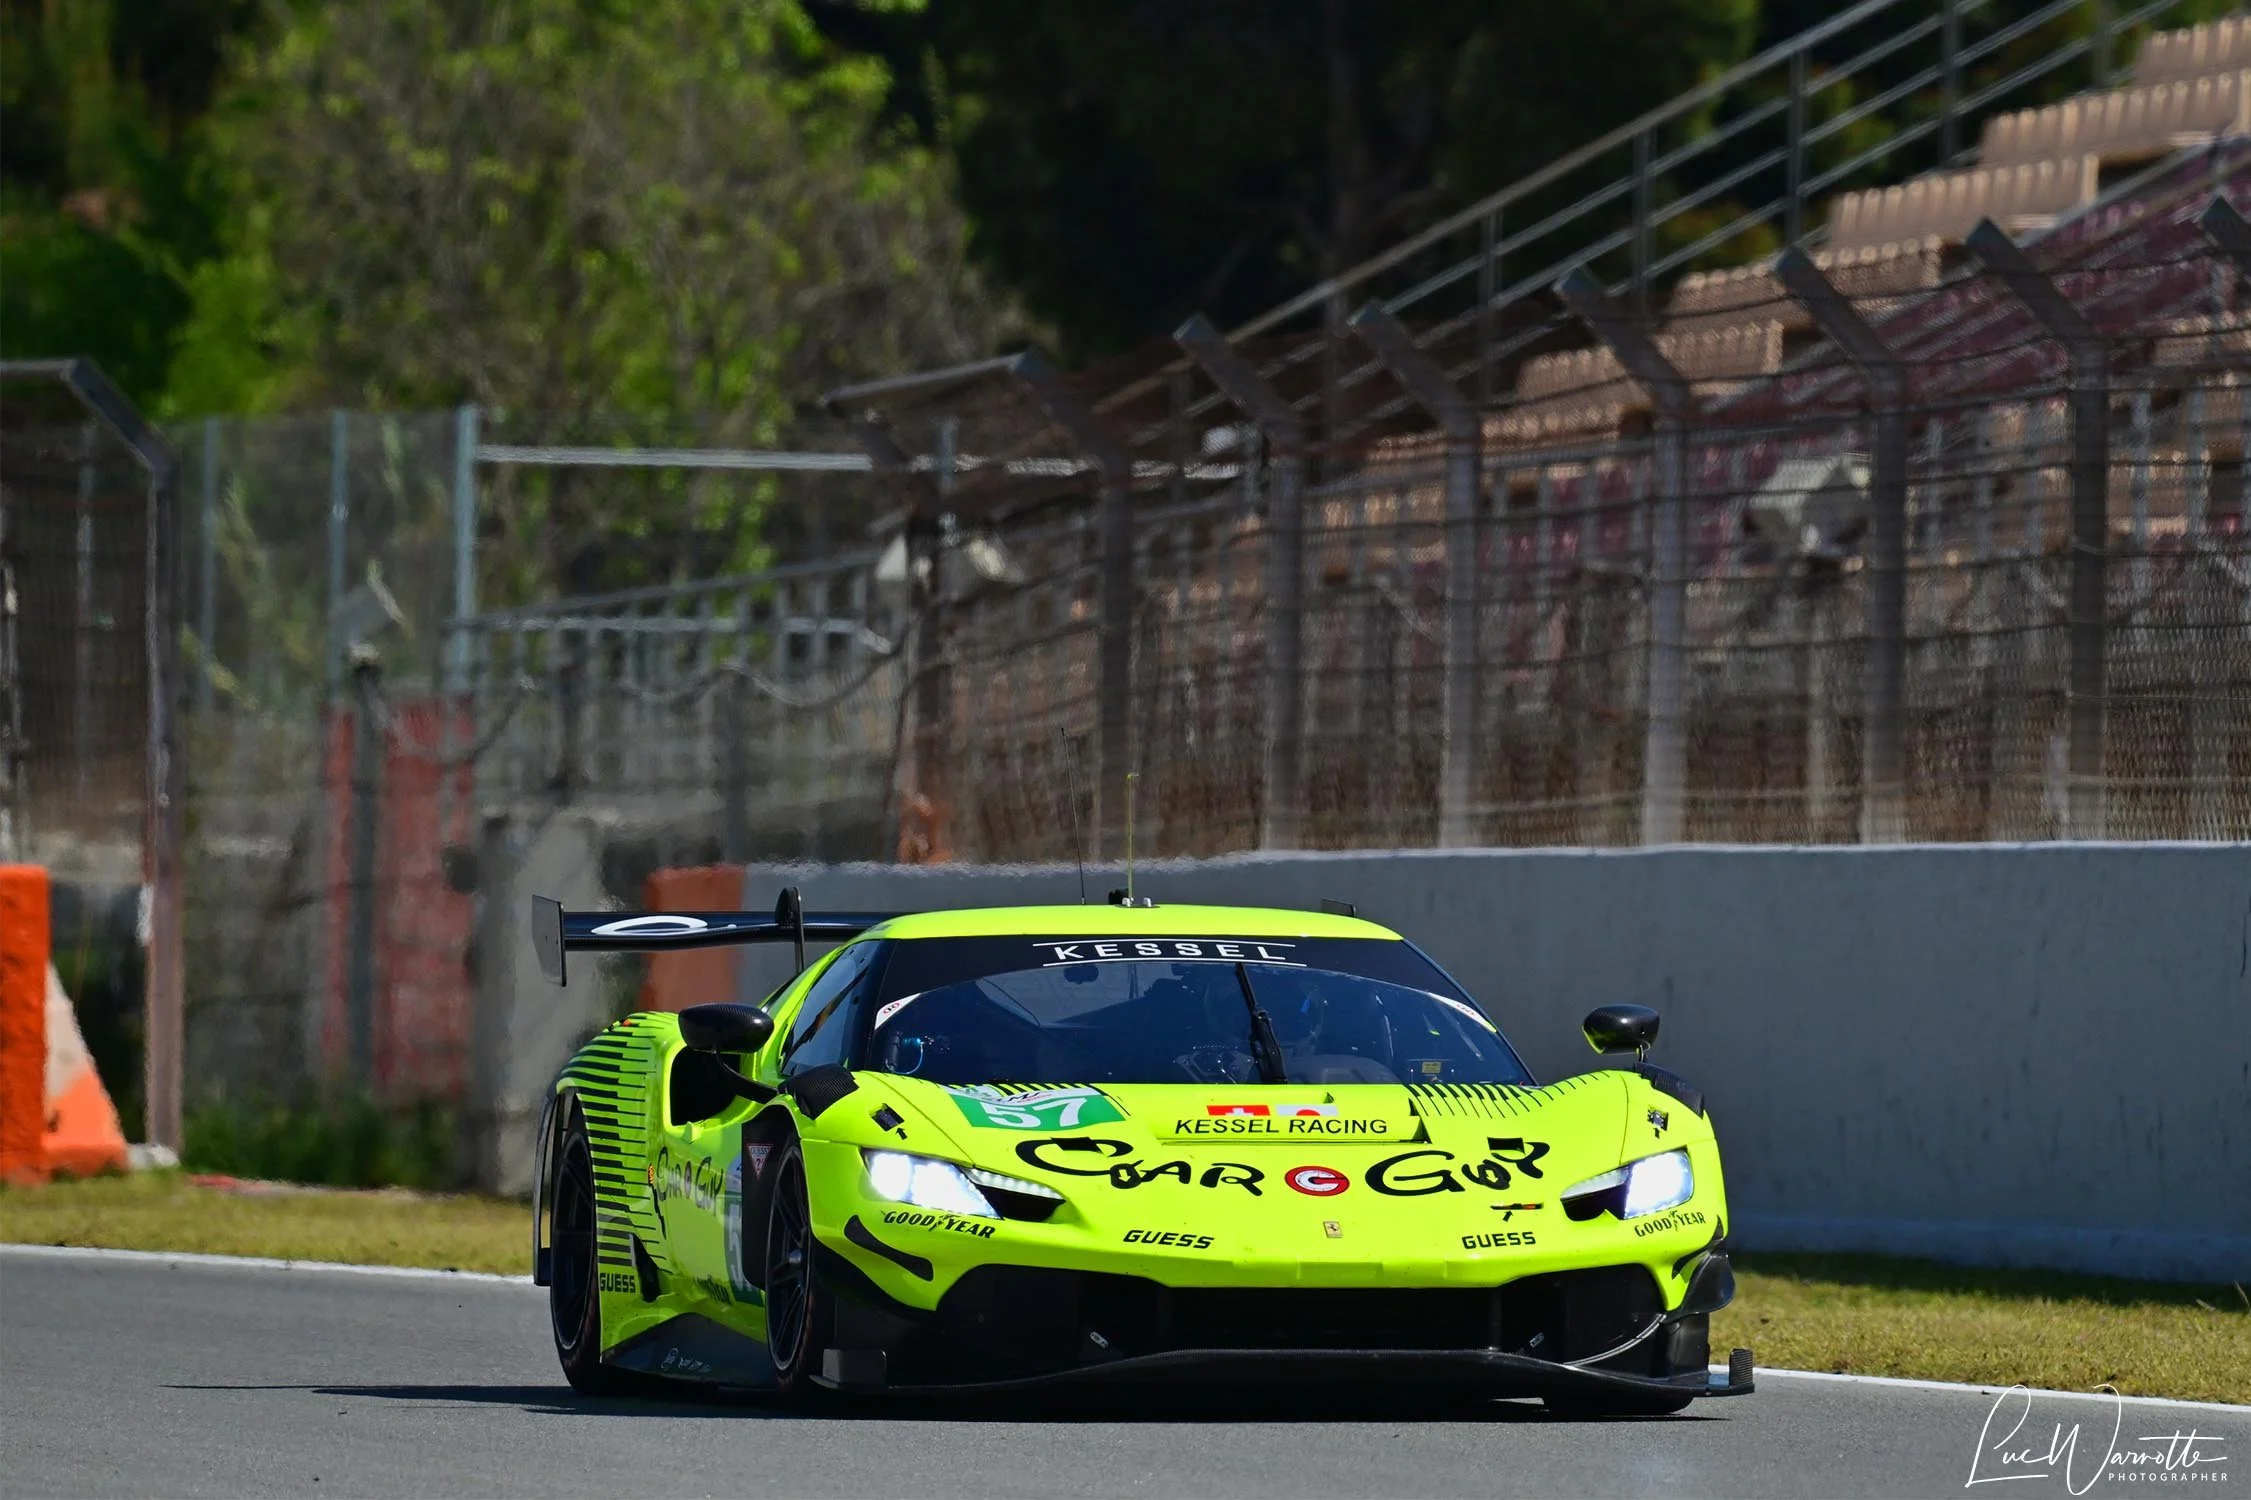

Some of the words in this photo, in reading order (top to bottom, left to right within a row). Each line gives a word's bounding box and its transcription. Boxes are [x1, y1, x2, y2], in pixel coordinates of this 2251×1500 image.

[1054, 943, 1286, 960] KESSEL
[980, 1097, 1088, 1127] 57
[1175, 1119, 1279, 1134] KESSEL
[1288, 1119, 1388, 1134] RACING
[1123, 1229, 1215, 1249] GUESS
[1462, 1231, 1537, 1250] GUESS
[600, 1272, 636, 1294] GUESS
